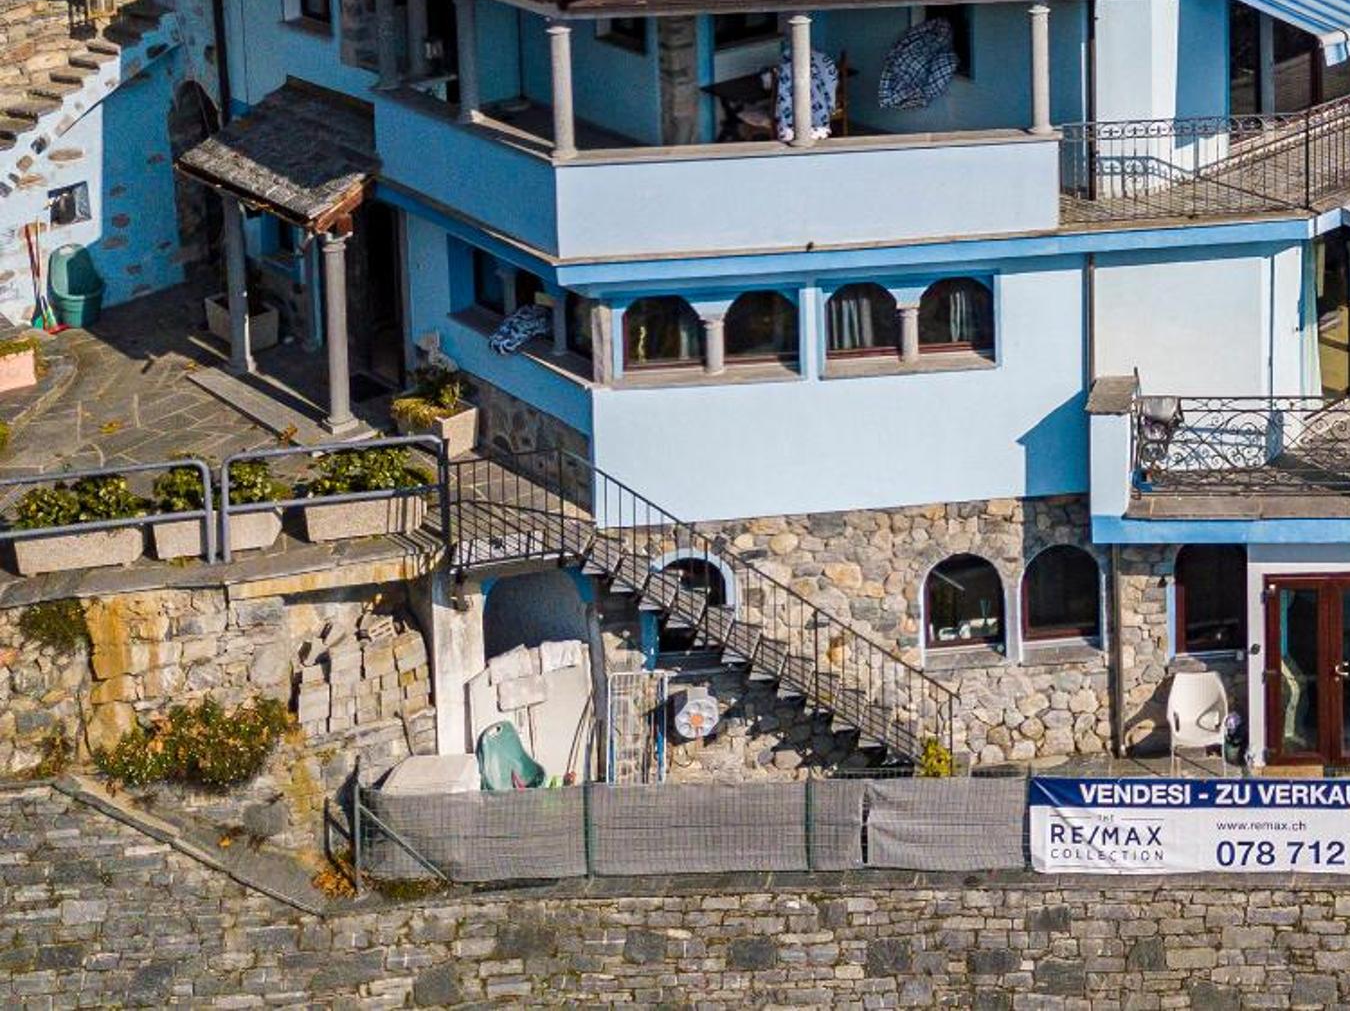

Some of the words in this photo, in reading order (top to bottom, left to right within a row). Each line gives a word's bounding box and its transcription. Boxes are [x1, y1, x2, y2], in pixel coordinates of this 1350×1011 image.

[1080, 784, 1191, 804] VENDESI
[1216, 784, 1250, 805] ZU
[1051, 824, 1162, 846] RE/MAX
[1216, 821, 1306, 831] www.remax.ch
[1050, 848, 1164, 862] COLLECTION
[1216, 841, 1275, 866] 078
[1287, 841, 1345, 865] 712
